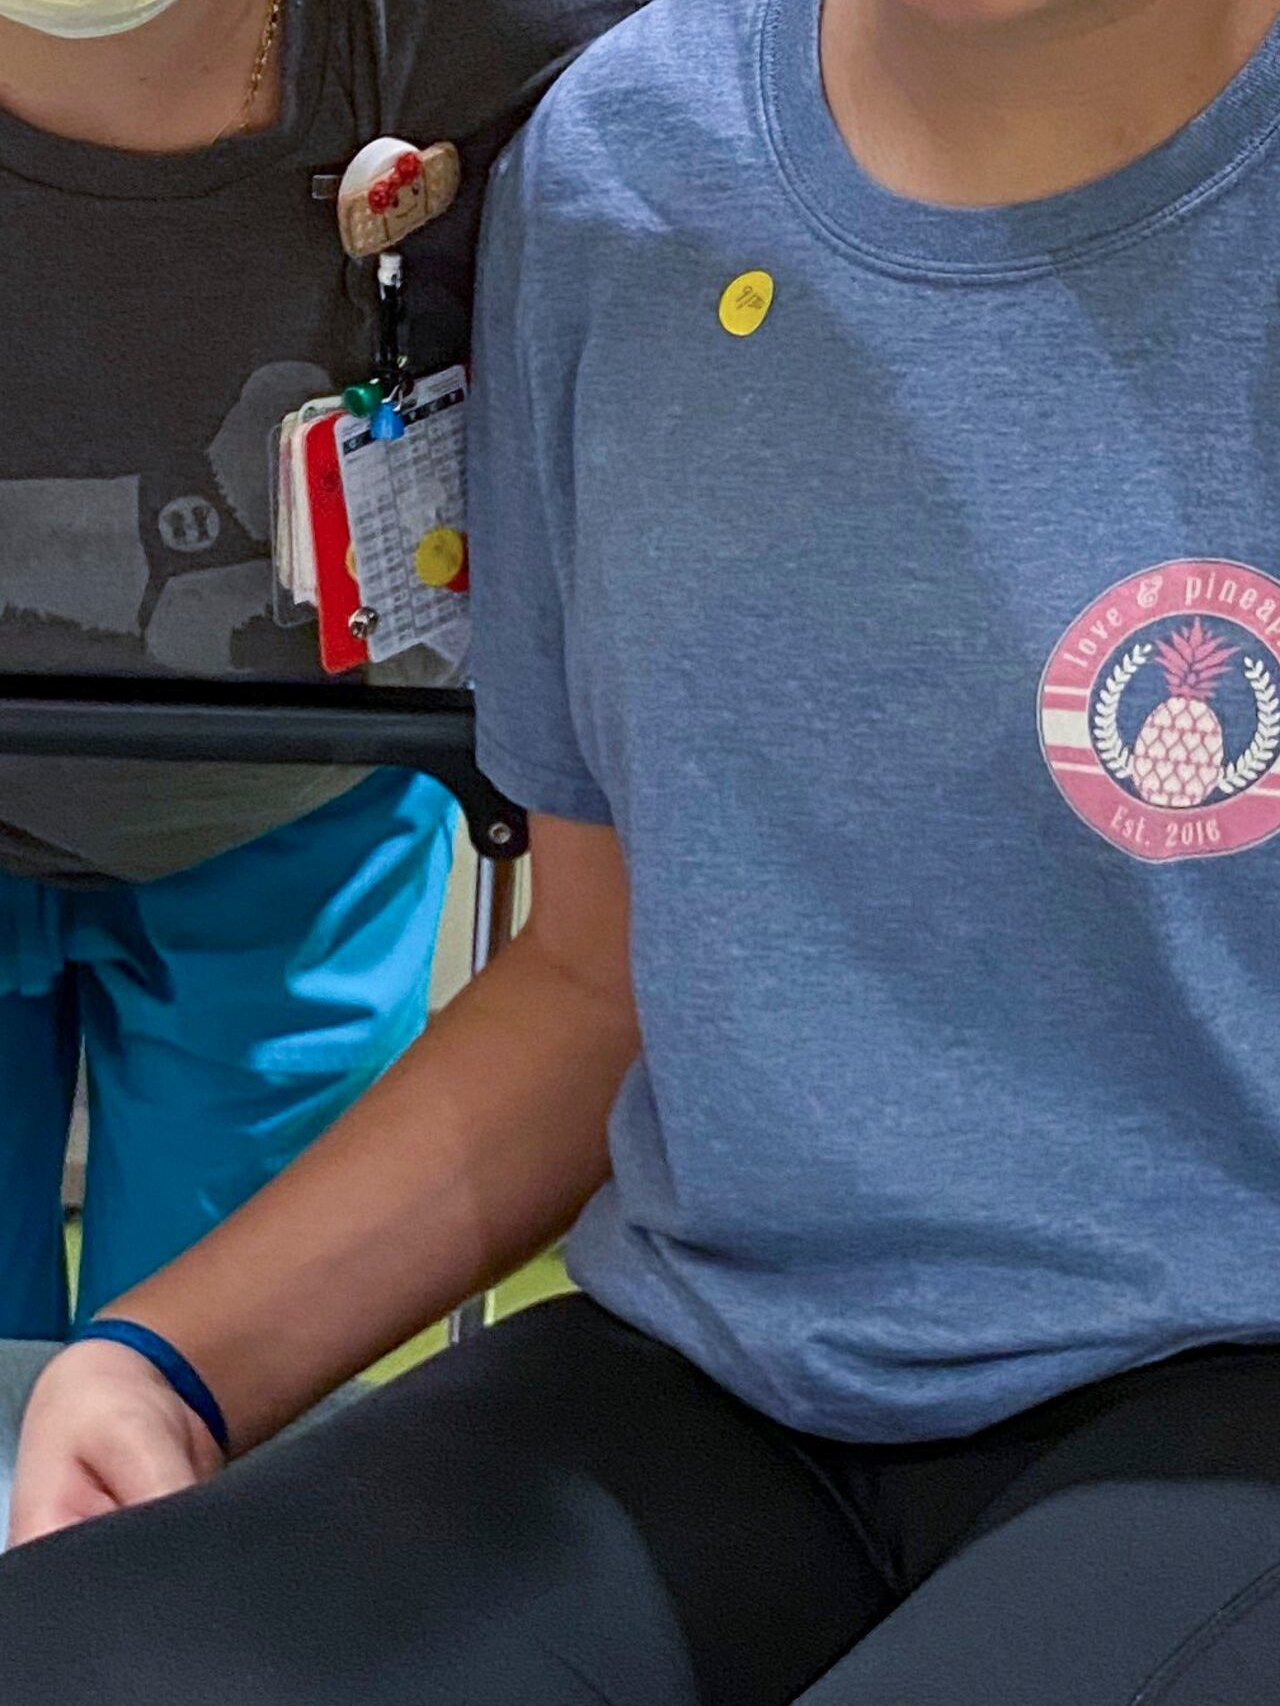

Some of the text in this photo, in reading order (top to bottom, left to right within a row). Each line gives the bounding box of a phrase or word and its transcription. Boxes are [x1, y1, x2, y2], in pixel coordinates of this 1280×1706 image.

[1063, 608, 1121, 668] love
[1136, 575, 1164, 609] &
[1110, 804, 1221, 849] Est. 2016
